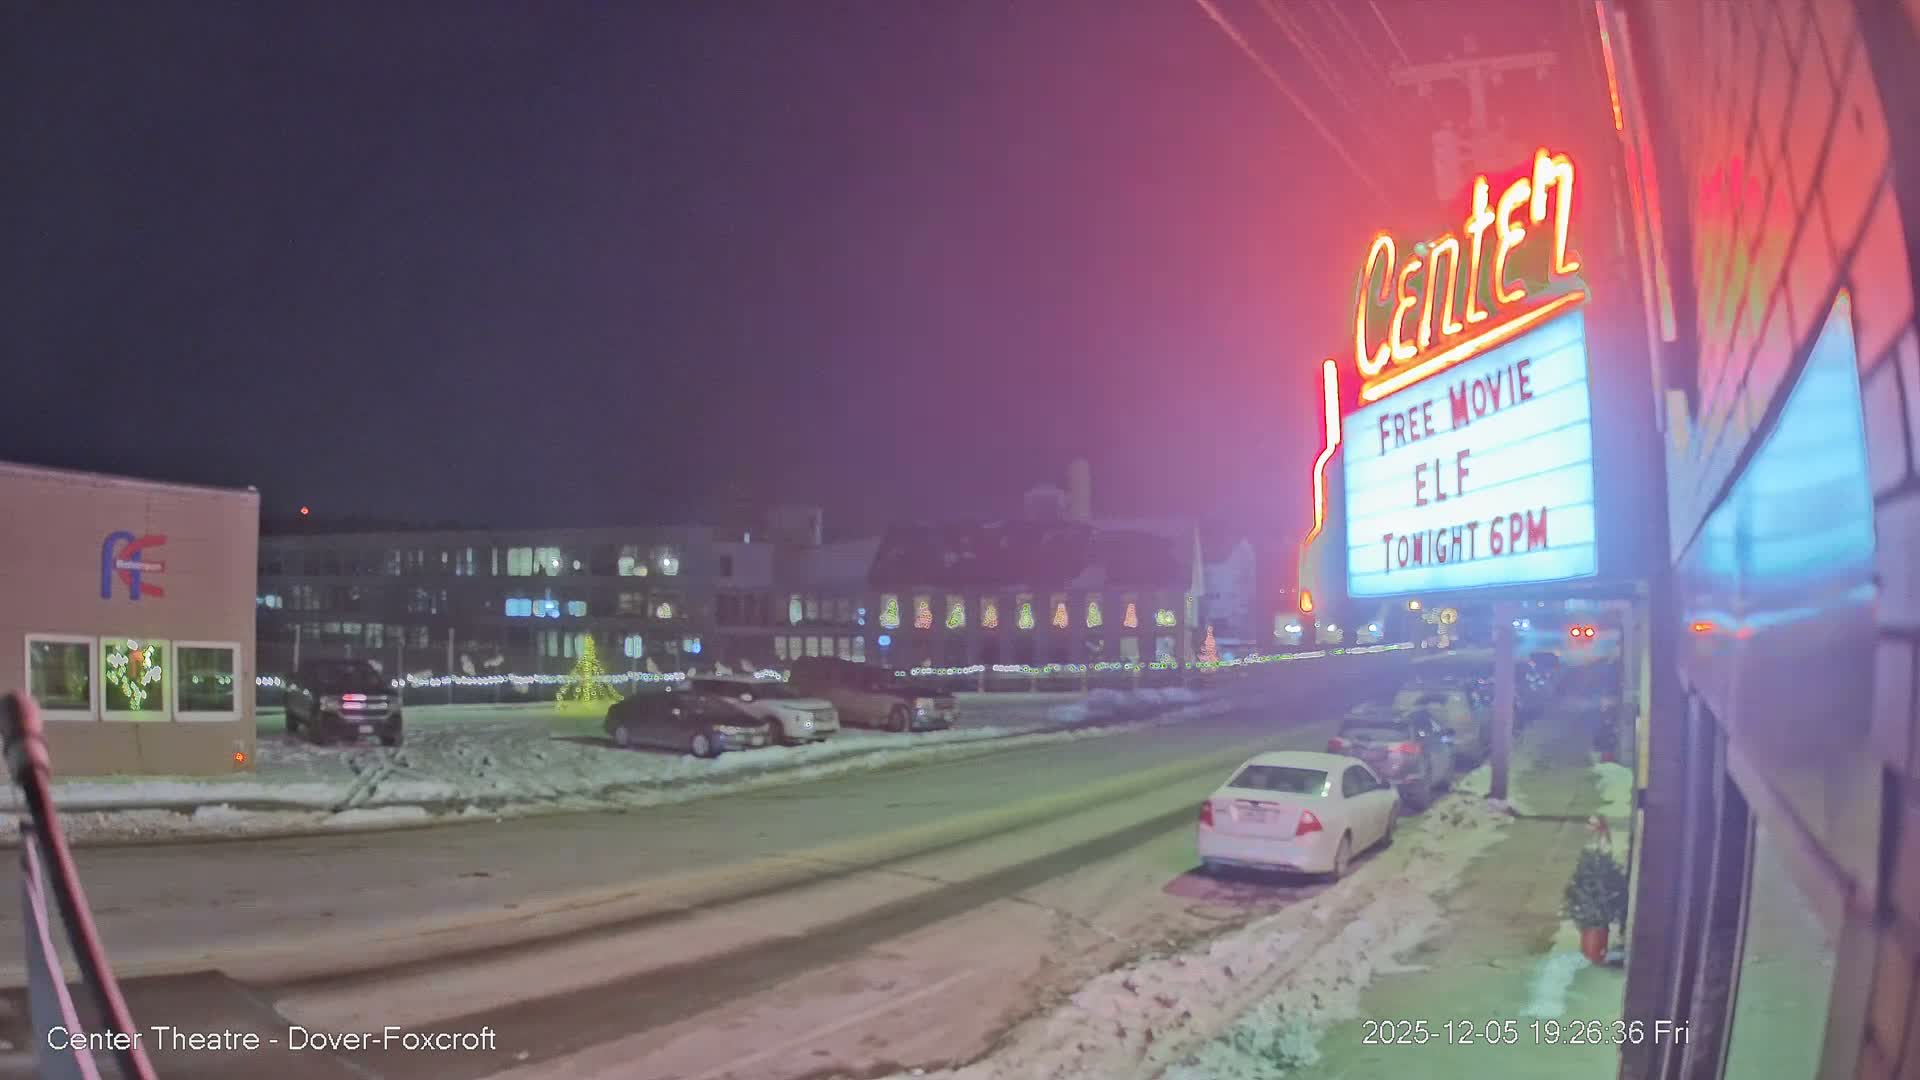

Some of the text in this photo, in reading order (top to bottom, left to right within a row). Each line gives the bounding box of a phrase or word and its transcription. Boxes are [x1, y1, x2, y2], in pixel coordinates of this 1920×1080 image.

[1379, 358, 1533, 456] FREE MOVIE
[1415, 448, 1470, 506] ELF
[1383, 506, 1548, 575] TONIGHT 6PM
